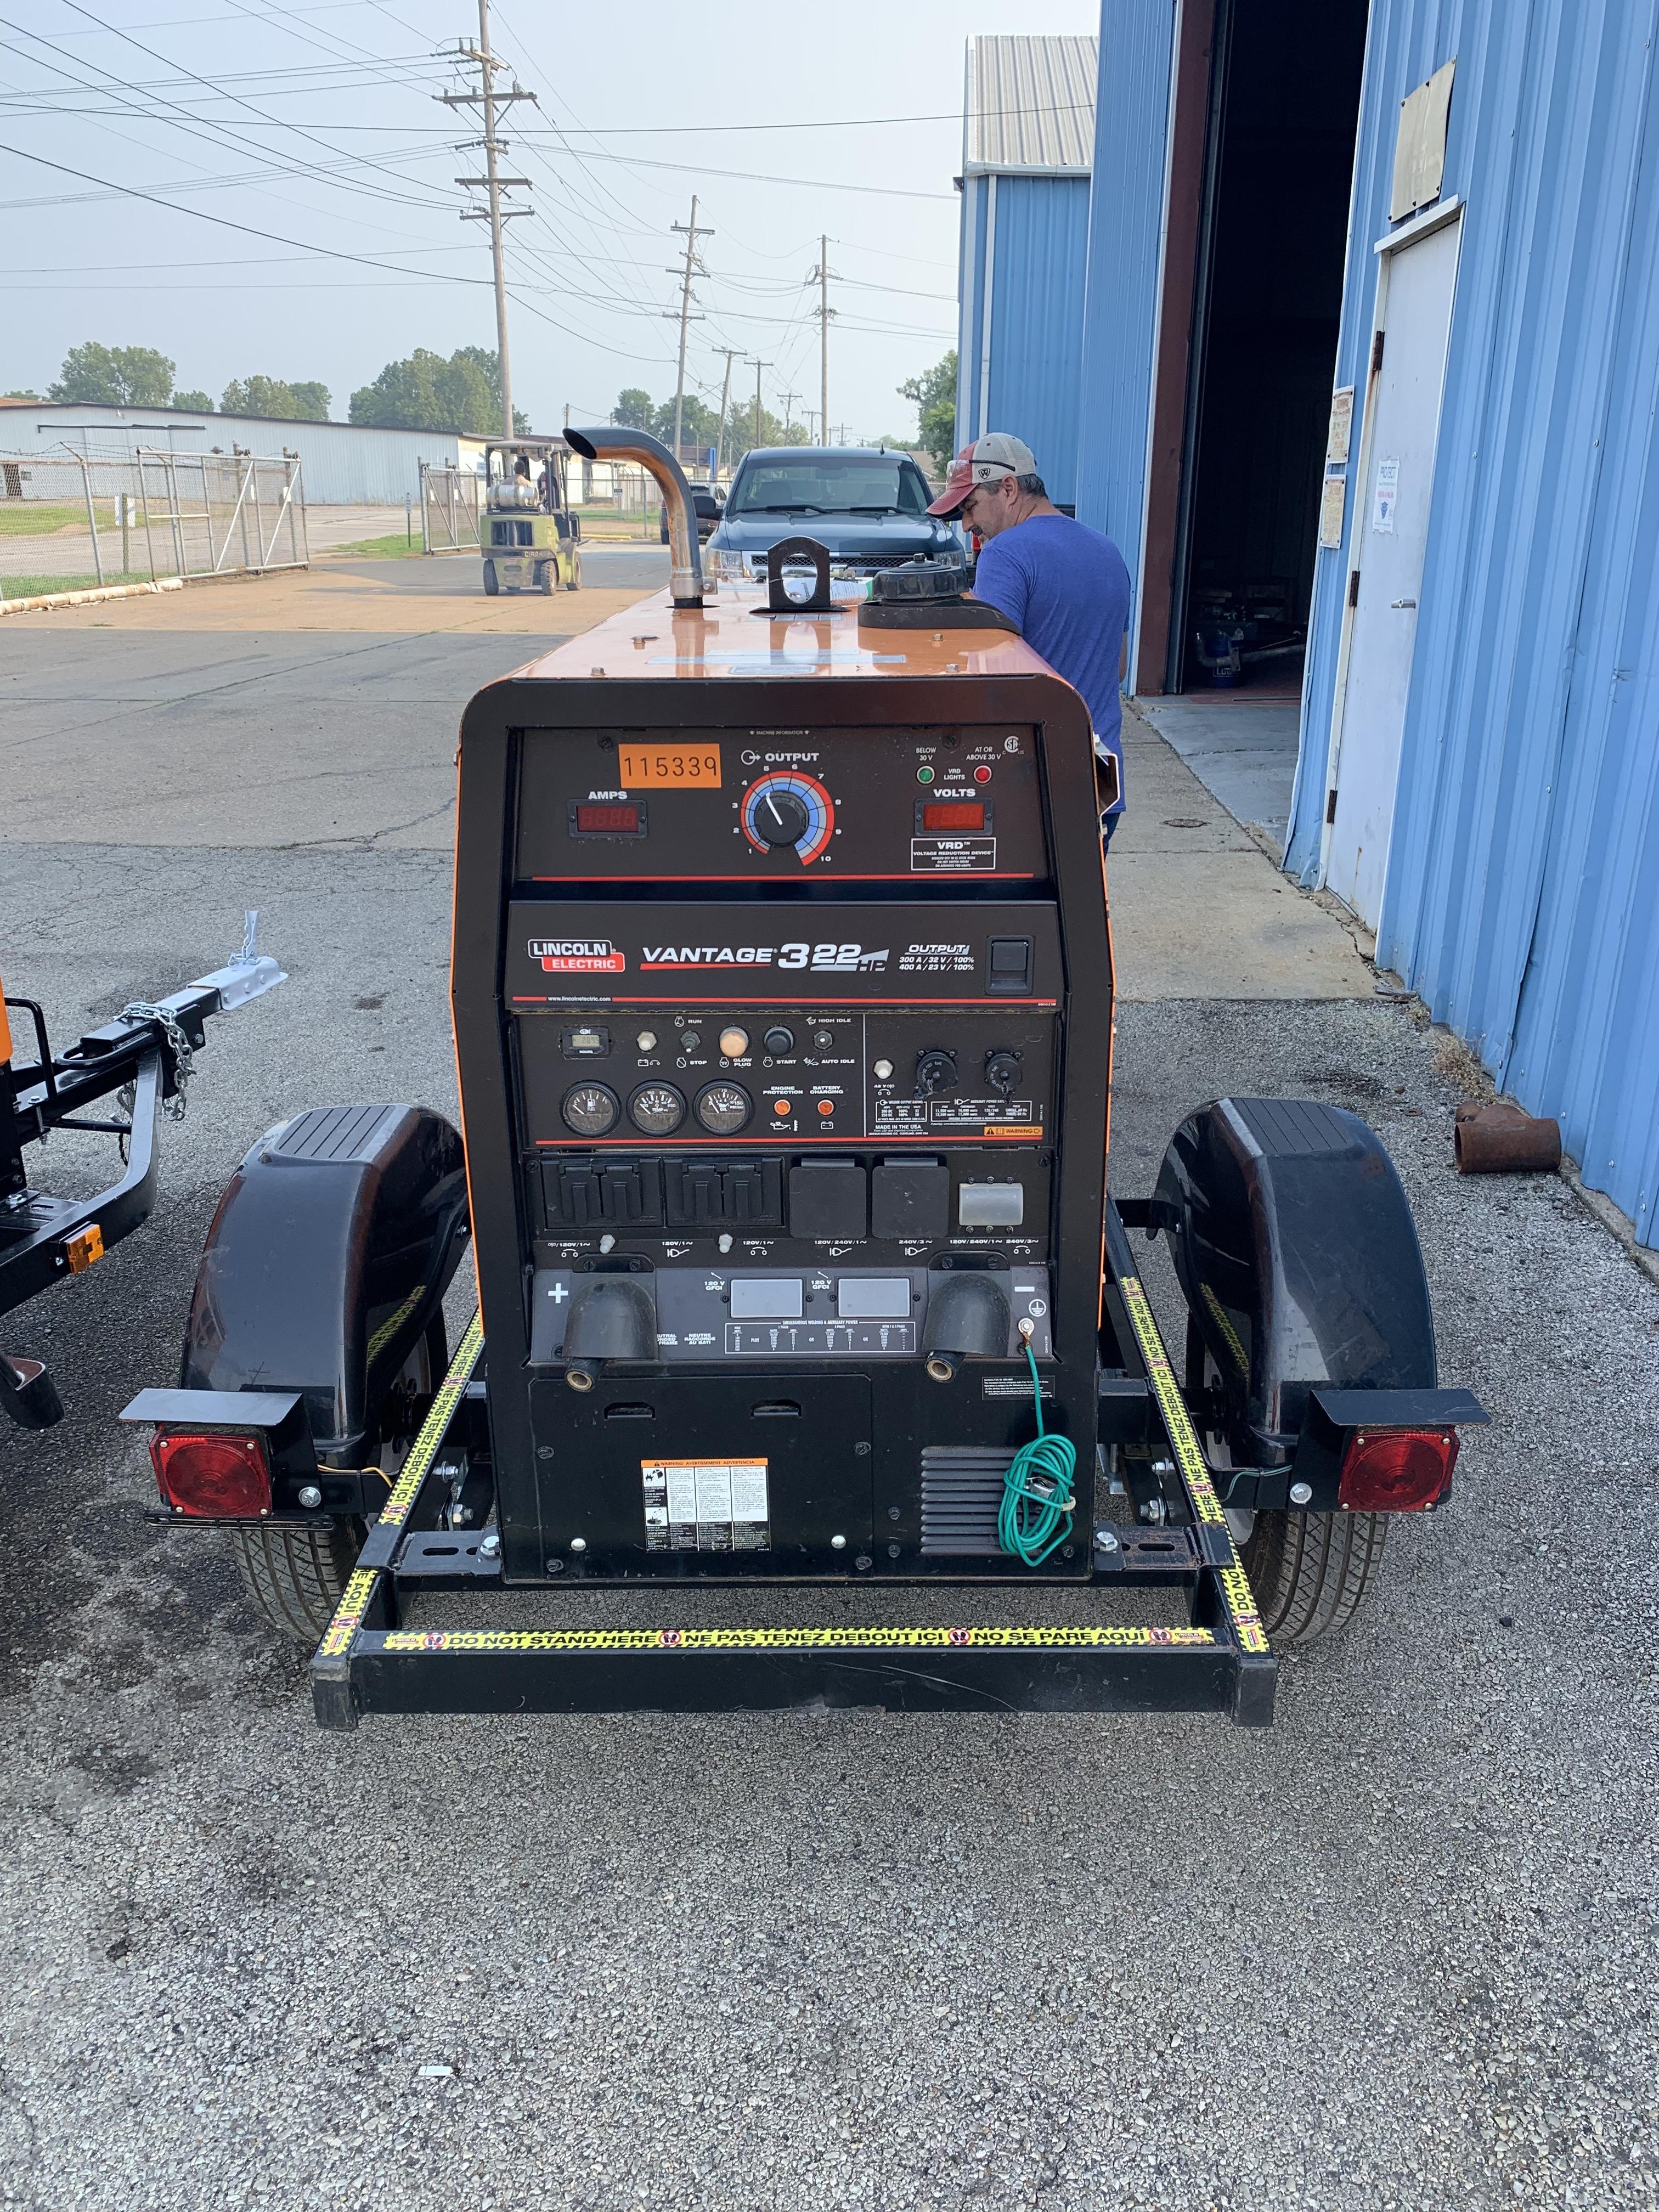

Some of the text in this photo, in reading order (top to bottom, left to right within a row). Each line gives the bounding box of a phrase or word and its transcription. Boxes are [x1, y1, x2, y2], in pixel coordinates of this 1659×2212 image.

[765, 753, 820, 762] OUTPUT
[624, 757, 717, 777] 115339
[588, 791, 628, 800] AMPS
[933, 788, 976, 797] VOLTS
[533, 943, 607, 956] LINCOLN
[909, 945, 966, 953] OUTPUT
[777, 943, 861, 969] 322
[551, 959, 617, 969] ELECTRIC
[1139, 1315, 1154, 1335] PARE
[1147, 1334, 1156, 1346] SE
[1151, 1346, 1159, 1358] NO
[454, 1357, 469, 1376] HERE
[1156, 1369, 1168, 1379] ICI
[1161, 1380, 1180, 1415] DEBOUT
[1173, 1415, 1189, 1447] TENEZ
[394, 1386, 456, 1502] NE PAS TENEZ DEBOUT ICI
[1182, 1447, 1199, 1470] PAS
[1190, 1469, 1203, 1482] NE
[1234, 1593, 1249, 1610] DO
[483, 1637, 526, 1645] NOT
[531, 1636, 596, 1644] STAND
[602, 1635, 656, 1644] HERE
[760, 1633, 825, 1641] TENEZ
[830, 1633, 912, 1641] DEBOUT
[974, 1630, 1145, 1641] NO SE PARE AQUÍ
